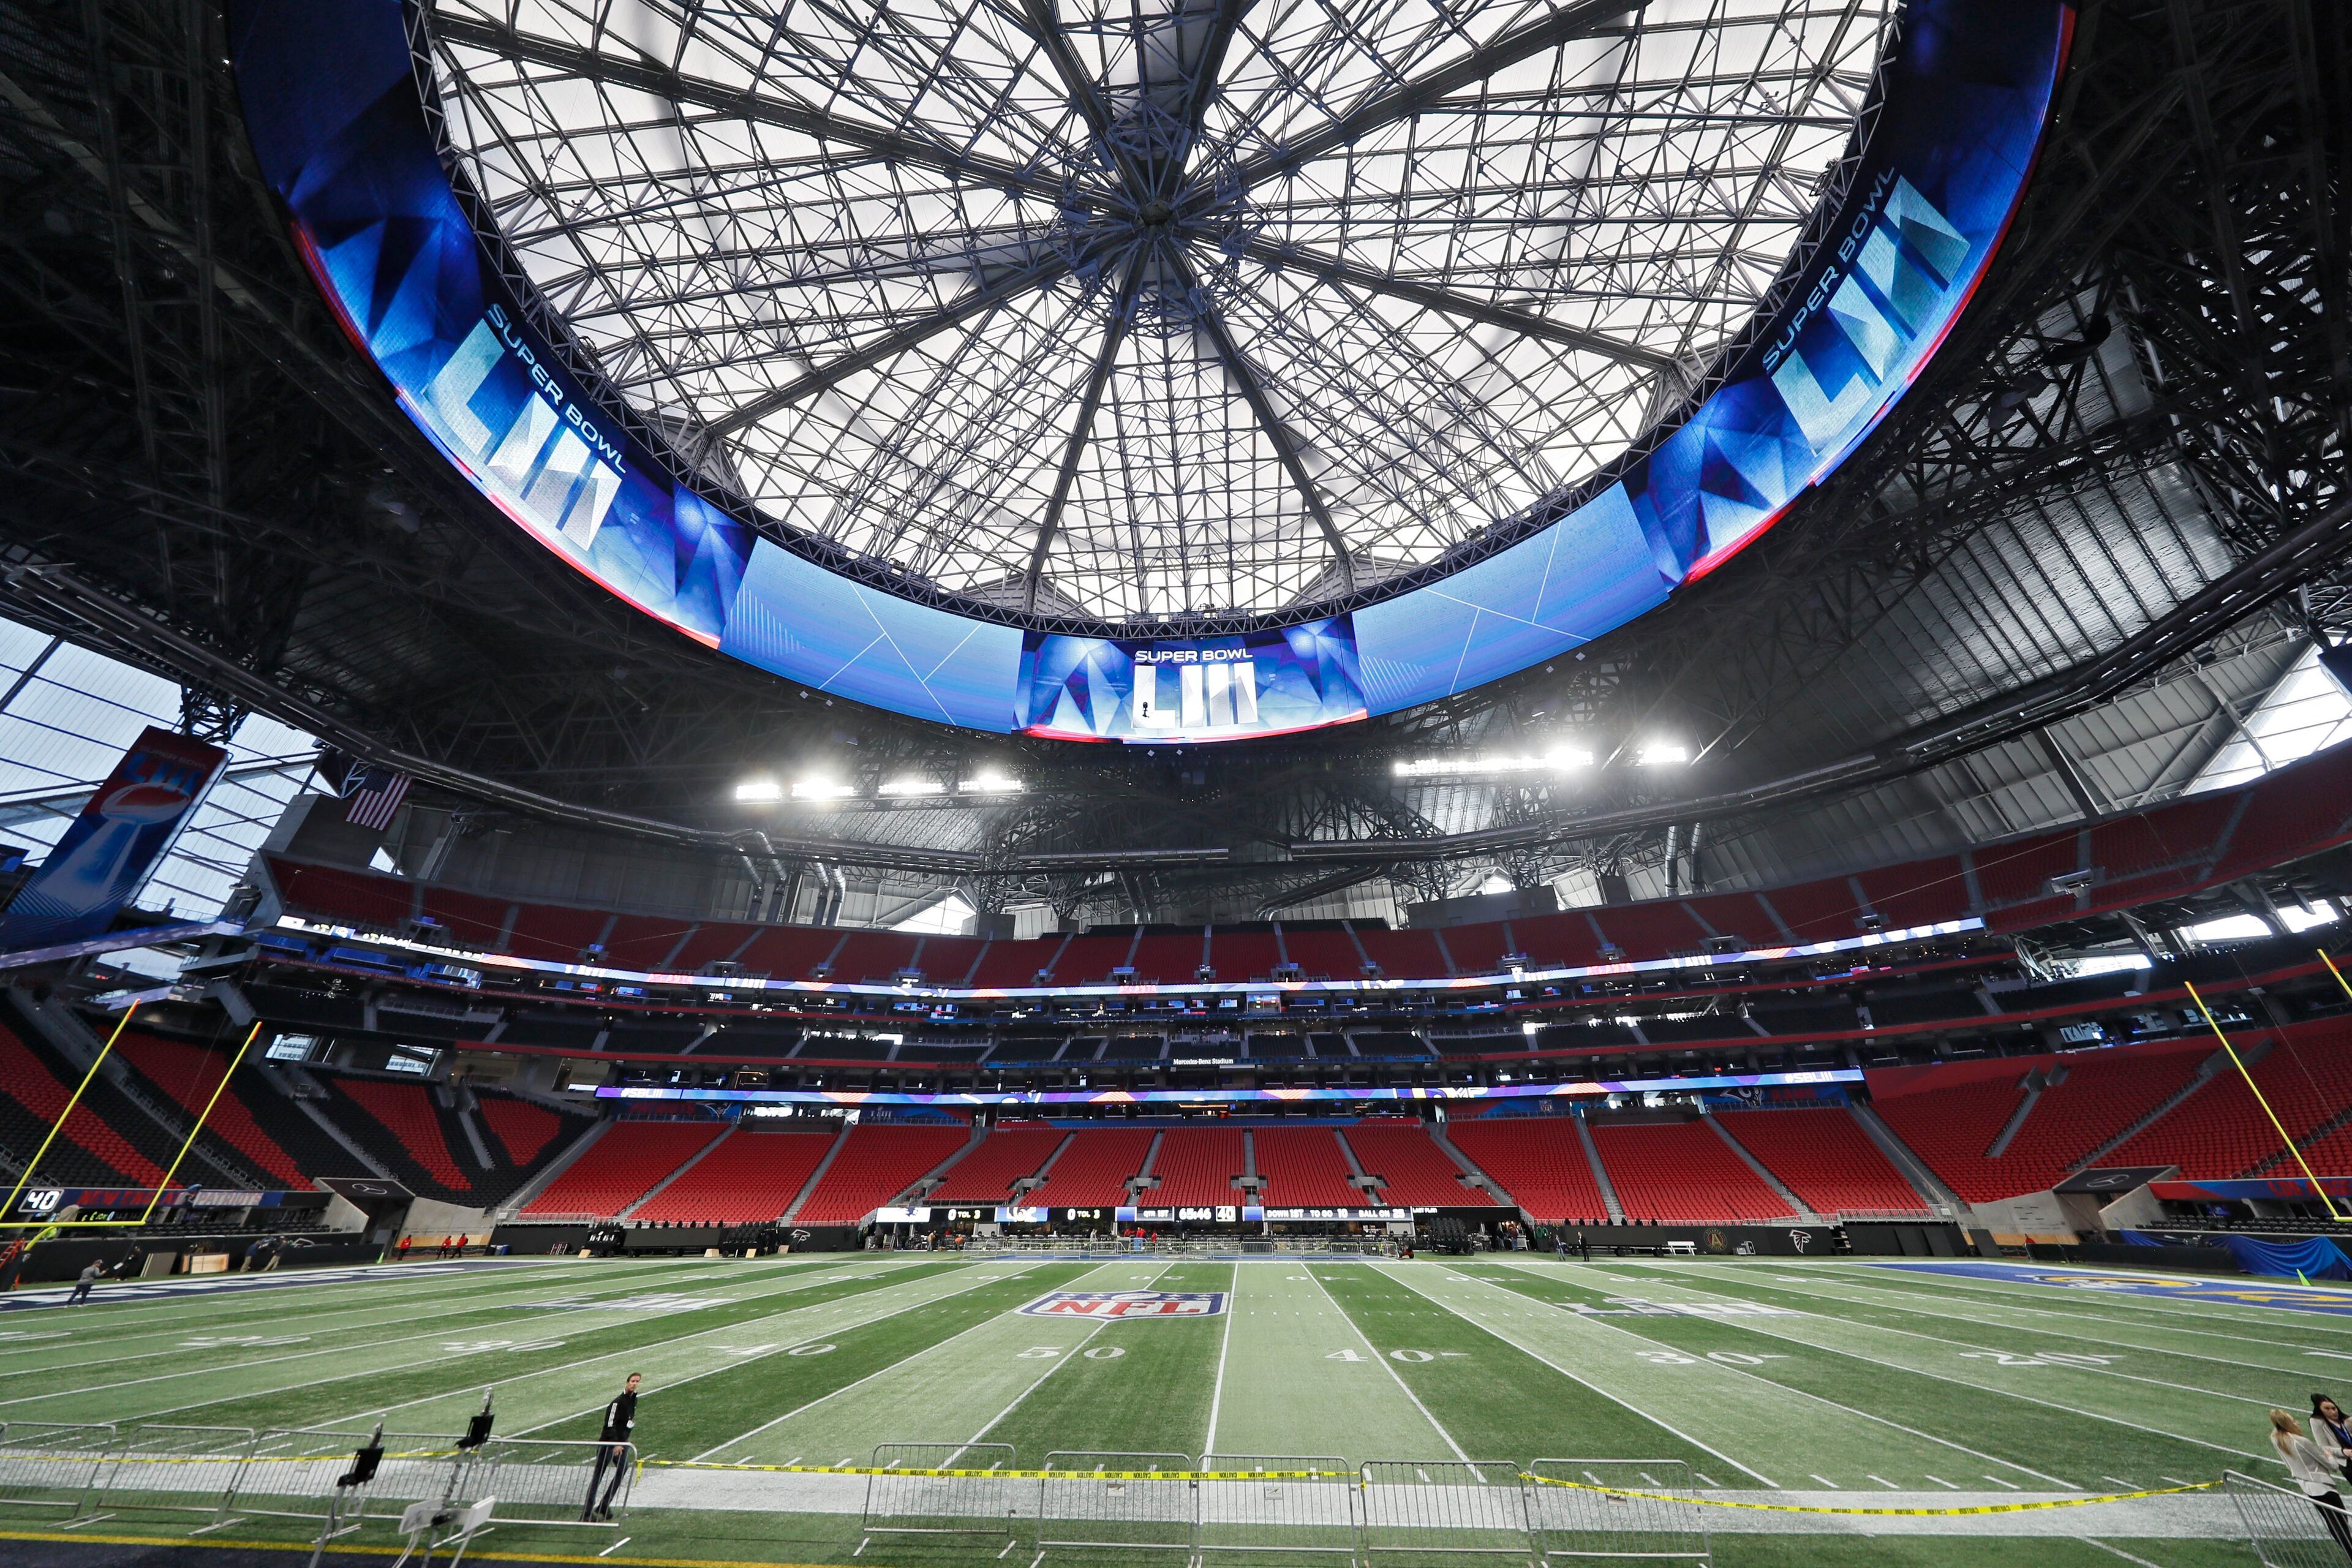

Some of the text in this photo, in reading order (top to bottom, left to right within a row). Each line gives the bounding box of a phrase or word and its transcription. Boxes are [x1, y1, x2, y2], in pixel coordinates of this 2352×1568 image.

[1762, 167, 1895, 370] SUPER BOWL
[1771, 175, 1970, 457] LIII
[488, 303, 626, 474] SUPER BOWL
[420, 318, 622, 551] LIII
[1134, 648, 1253, 663] SUPER BOWL
[1131, 662, 1259, 729] LIII
[1785, 1072, 1834, 1084] #SBLIII
[620, 1088, 663, 1098] #SBLIII
[28, 1191, 59, 1210] 40
[948, 1208, 957, 1221] 0
[973, 1210, 981, 1219] 3
[1067, 1208, 1076, 1221] 0
[1093, 1210, 1100, 1219] 3
[1179, 1208, 1212, 1220] 65:46
[1217, 1207, 1235, 1220] 40
[1289, 1208, 1304, 1218] 1ST
[1337, 1208, 1348, 1218] 10
[1044, 1300, 1203, 1316] NFL
